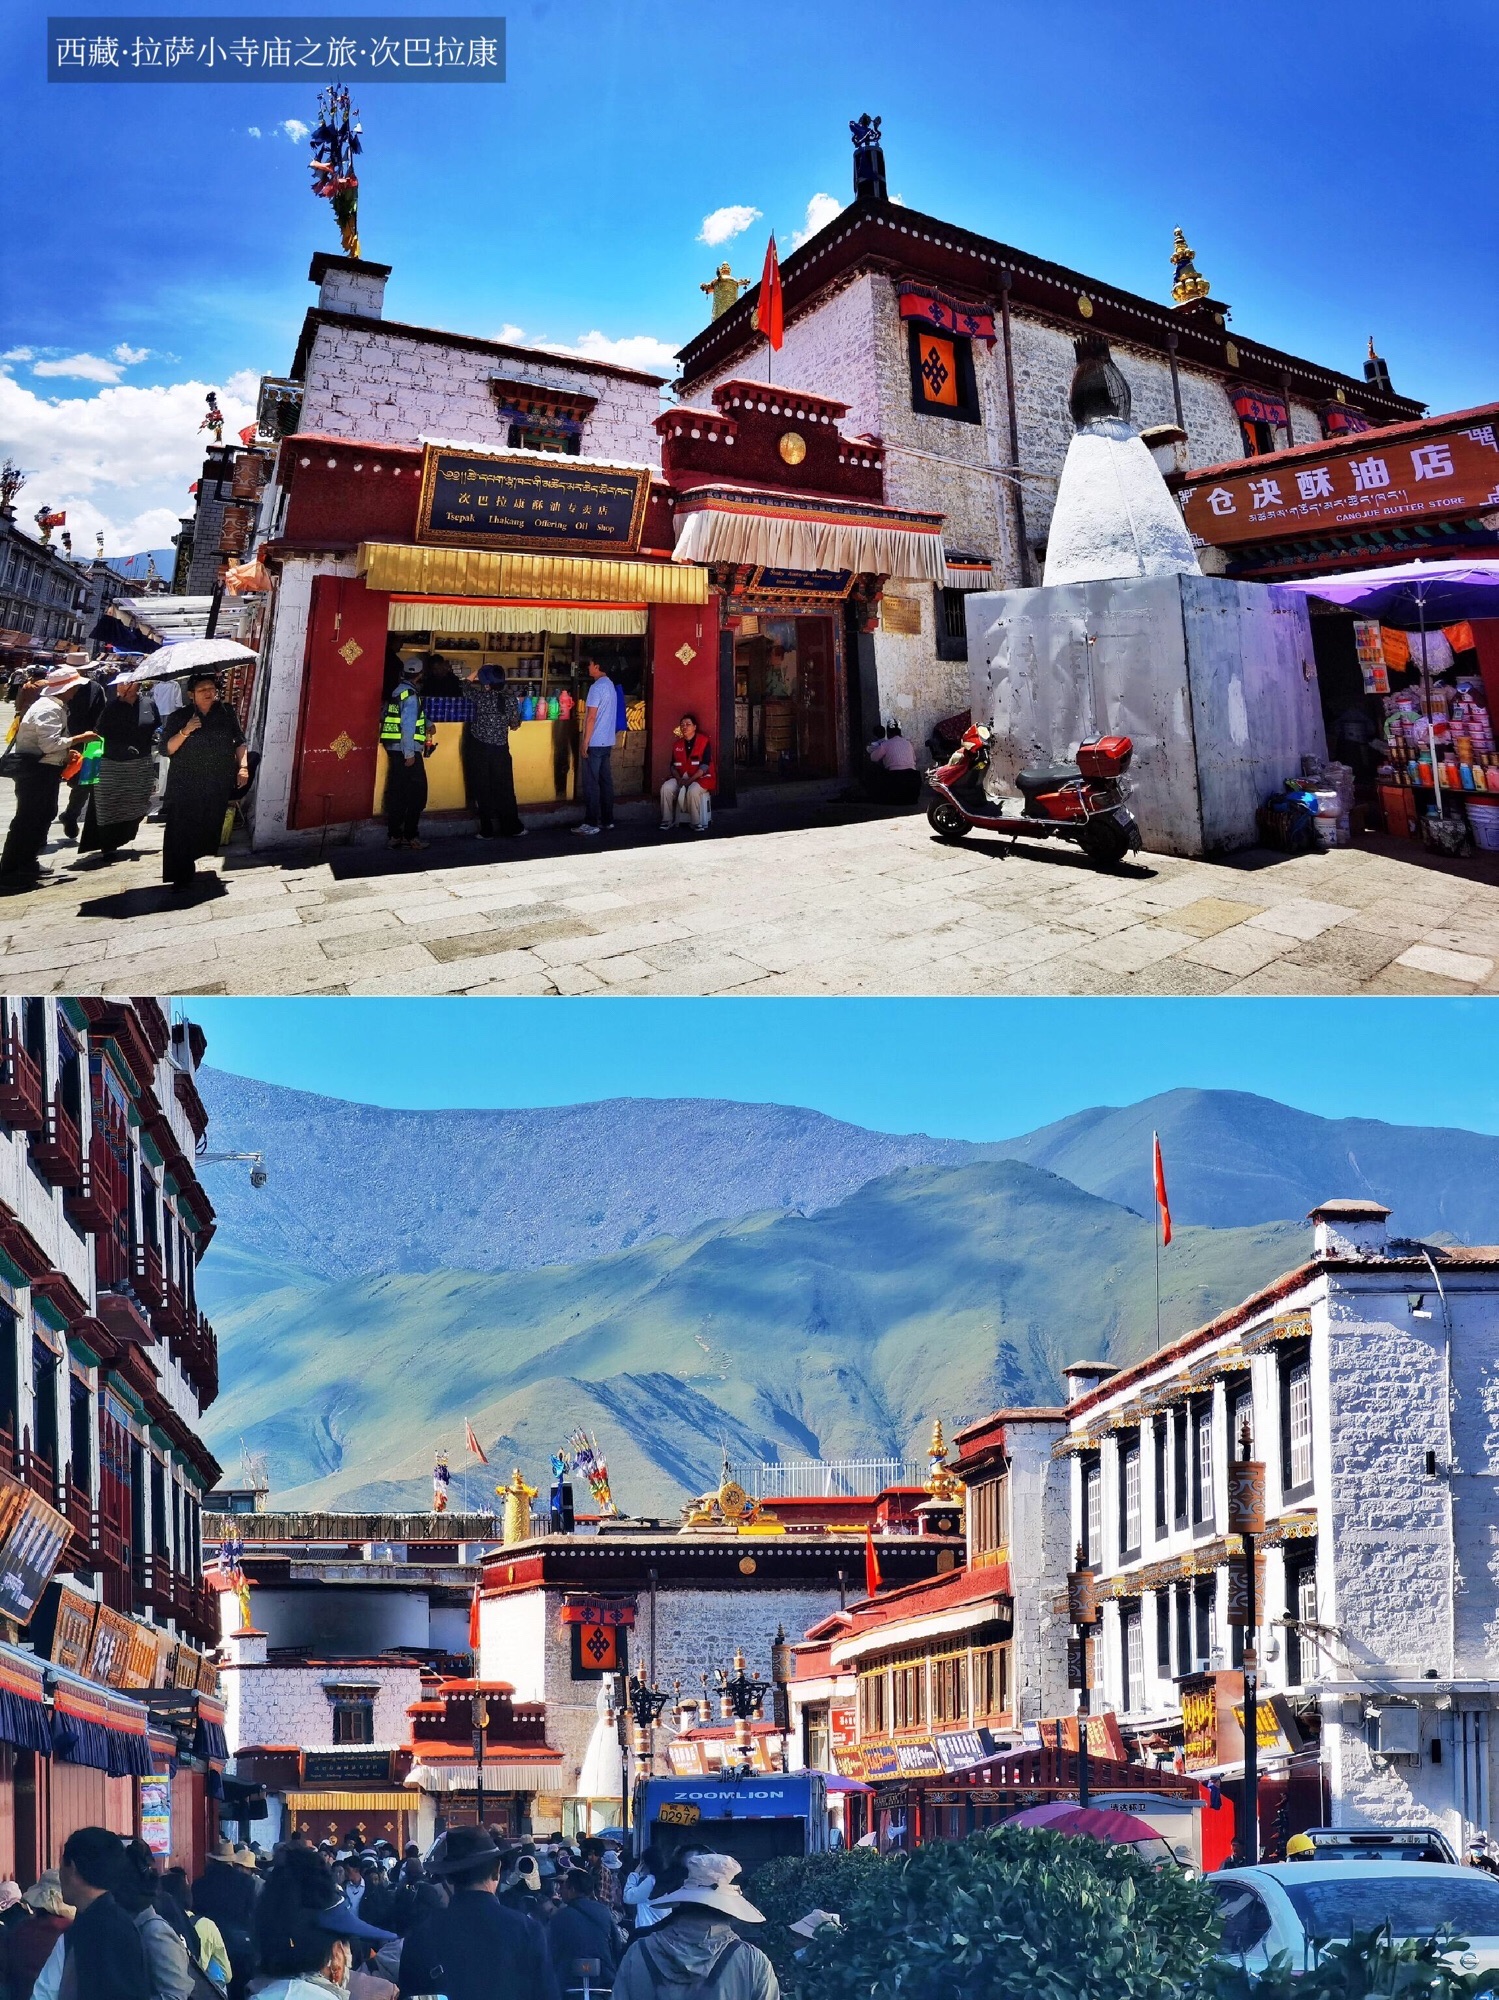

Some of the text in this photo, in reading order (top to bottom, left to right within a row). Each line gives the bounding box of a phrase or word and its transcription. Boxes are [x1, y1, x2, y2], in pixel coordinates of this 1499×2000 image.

[1206, 444, 1454, 515] 仓决酥油店
[458, 493, 608, 516] 次巴拉康酥油专卖店
[1336, 496, 1466, 522] CANGJUE BUTTER STORE
[446, 511, 615, 534] Tsepak Lhakang Offering Oil Shop
[674, 1791, 784, 1800] ZOOMLION
